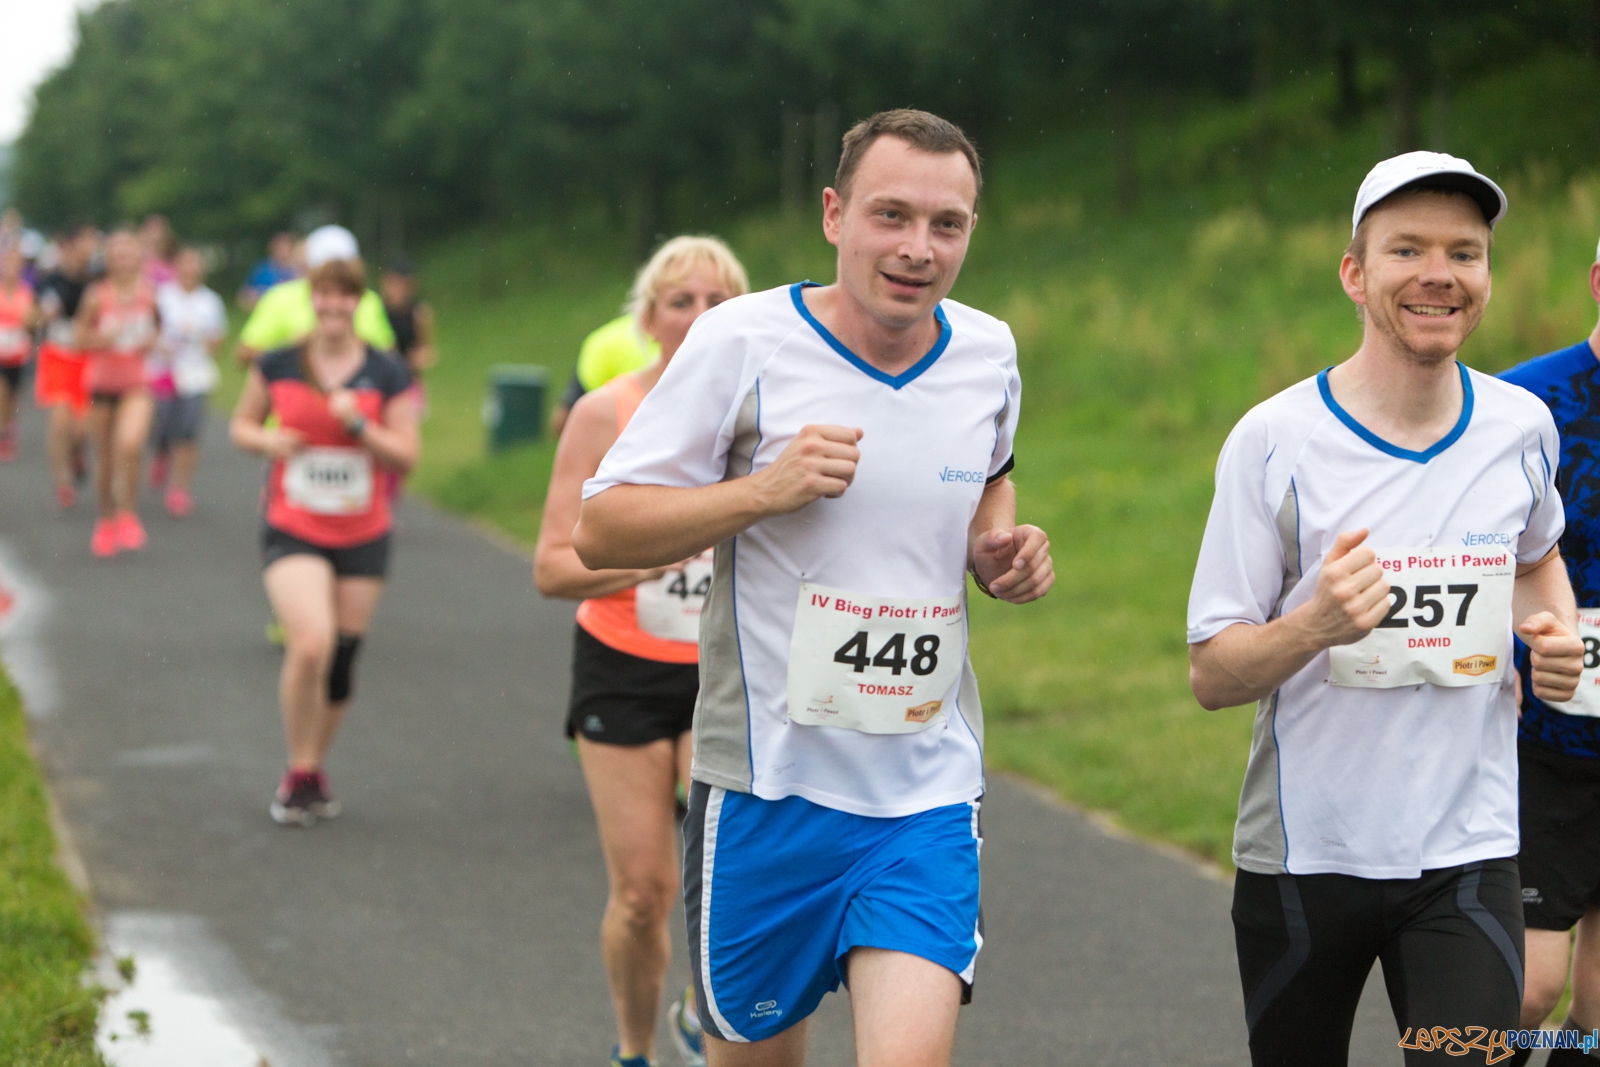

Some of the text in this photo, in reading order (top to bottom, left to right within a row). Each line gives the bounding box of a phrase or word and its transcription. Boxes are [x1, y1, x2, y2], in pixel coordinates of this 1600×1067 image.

[1377, 553, 1507, 572] ieg Piotr i Paweł
[811, 594, 830, 608] IV
[834, 598, 873, 619] Bieg
[878, 605, 918, 619] Piotr
[923, 606, 928, 618] i
[1374, 584, 1479, 628] 257
[1408, 637, 1451, 648] DAWID
[833, 631, 940, 676] 448
[1455, 661, 1473, 670] Piotr
[1474, 660, 1478, 668] i
[857, 683, 914, 696] TOMASZ
